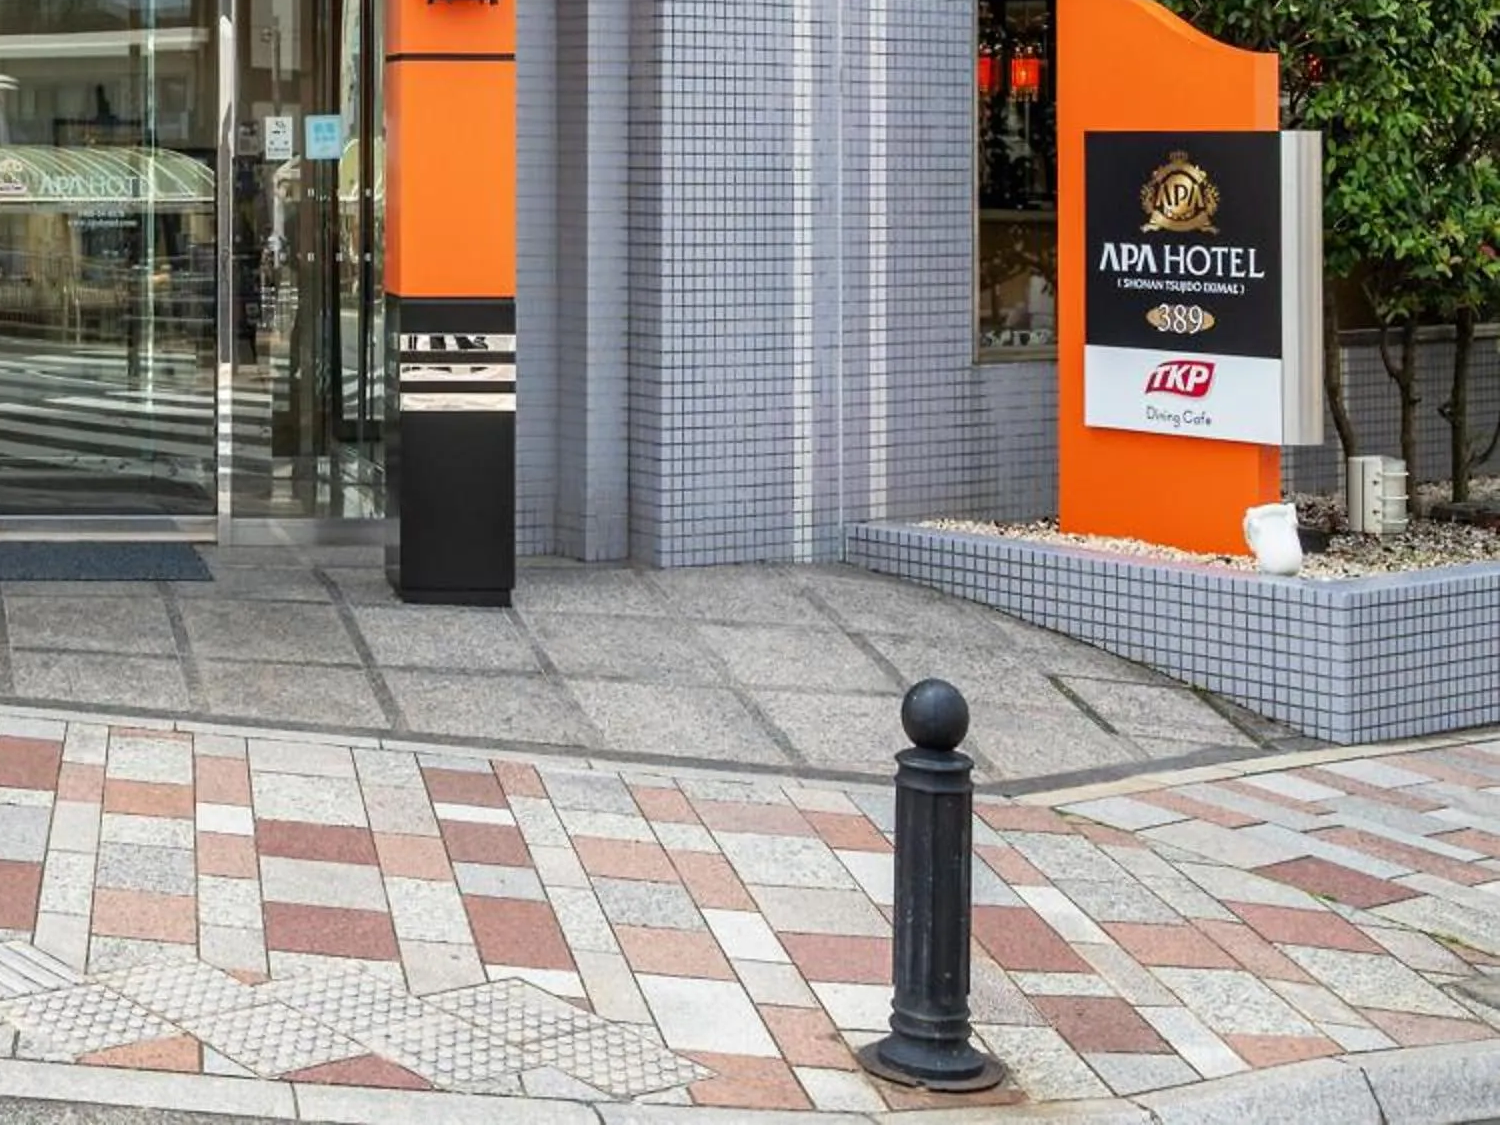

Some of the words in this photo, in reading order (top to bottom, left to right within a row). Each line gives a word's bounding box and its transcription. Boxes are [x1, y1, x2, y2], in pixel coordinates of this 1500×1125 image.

[1154, 183, 1205, 209] APA
[1099, 242, 1158, 273] APA
[1163, 245, 1265, 278] HOTEL
[1157, 302, 1203, 334] 389
[1151, 363, 1210, 393] TKP
[1145, 405, 1181, 427] Dining
[1182, 409, 1212, 426] Cafe
